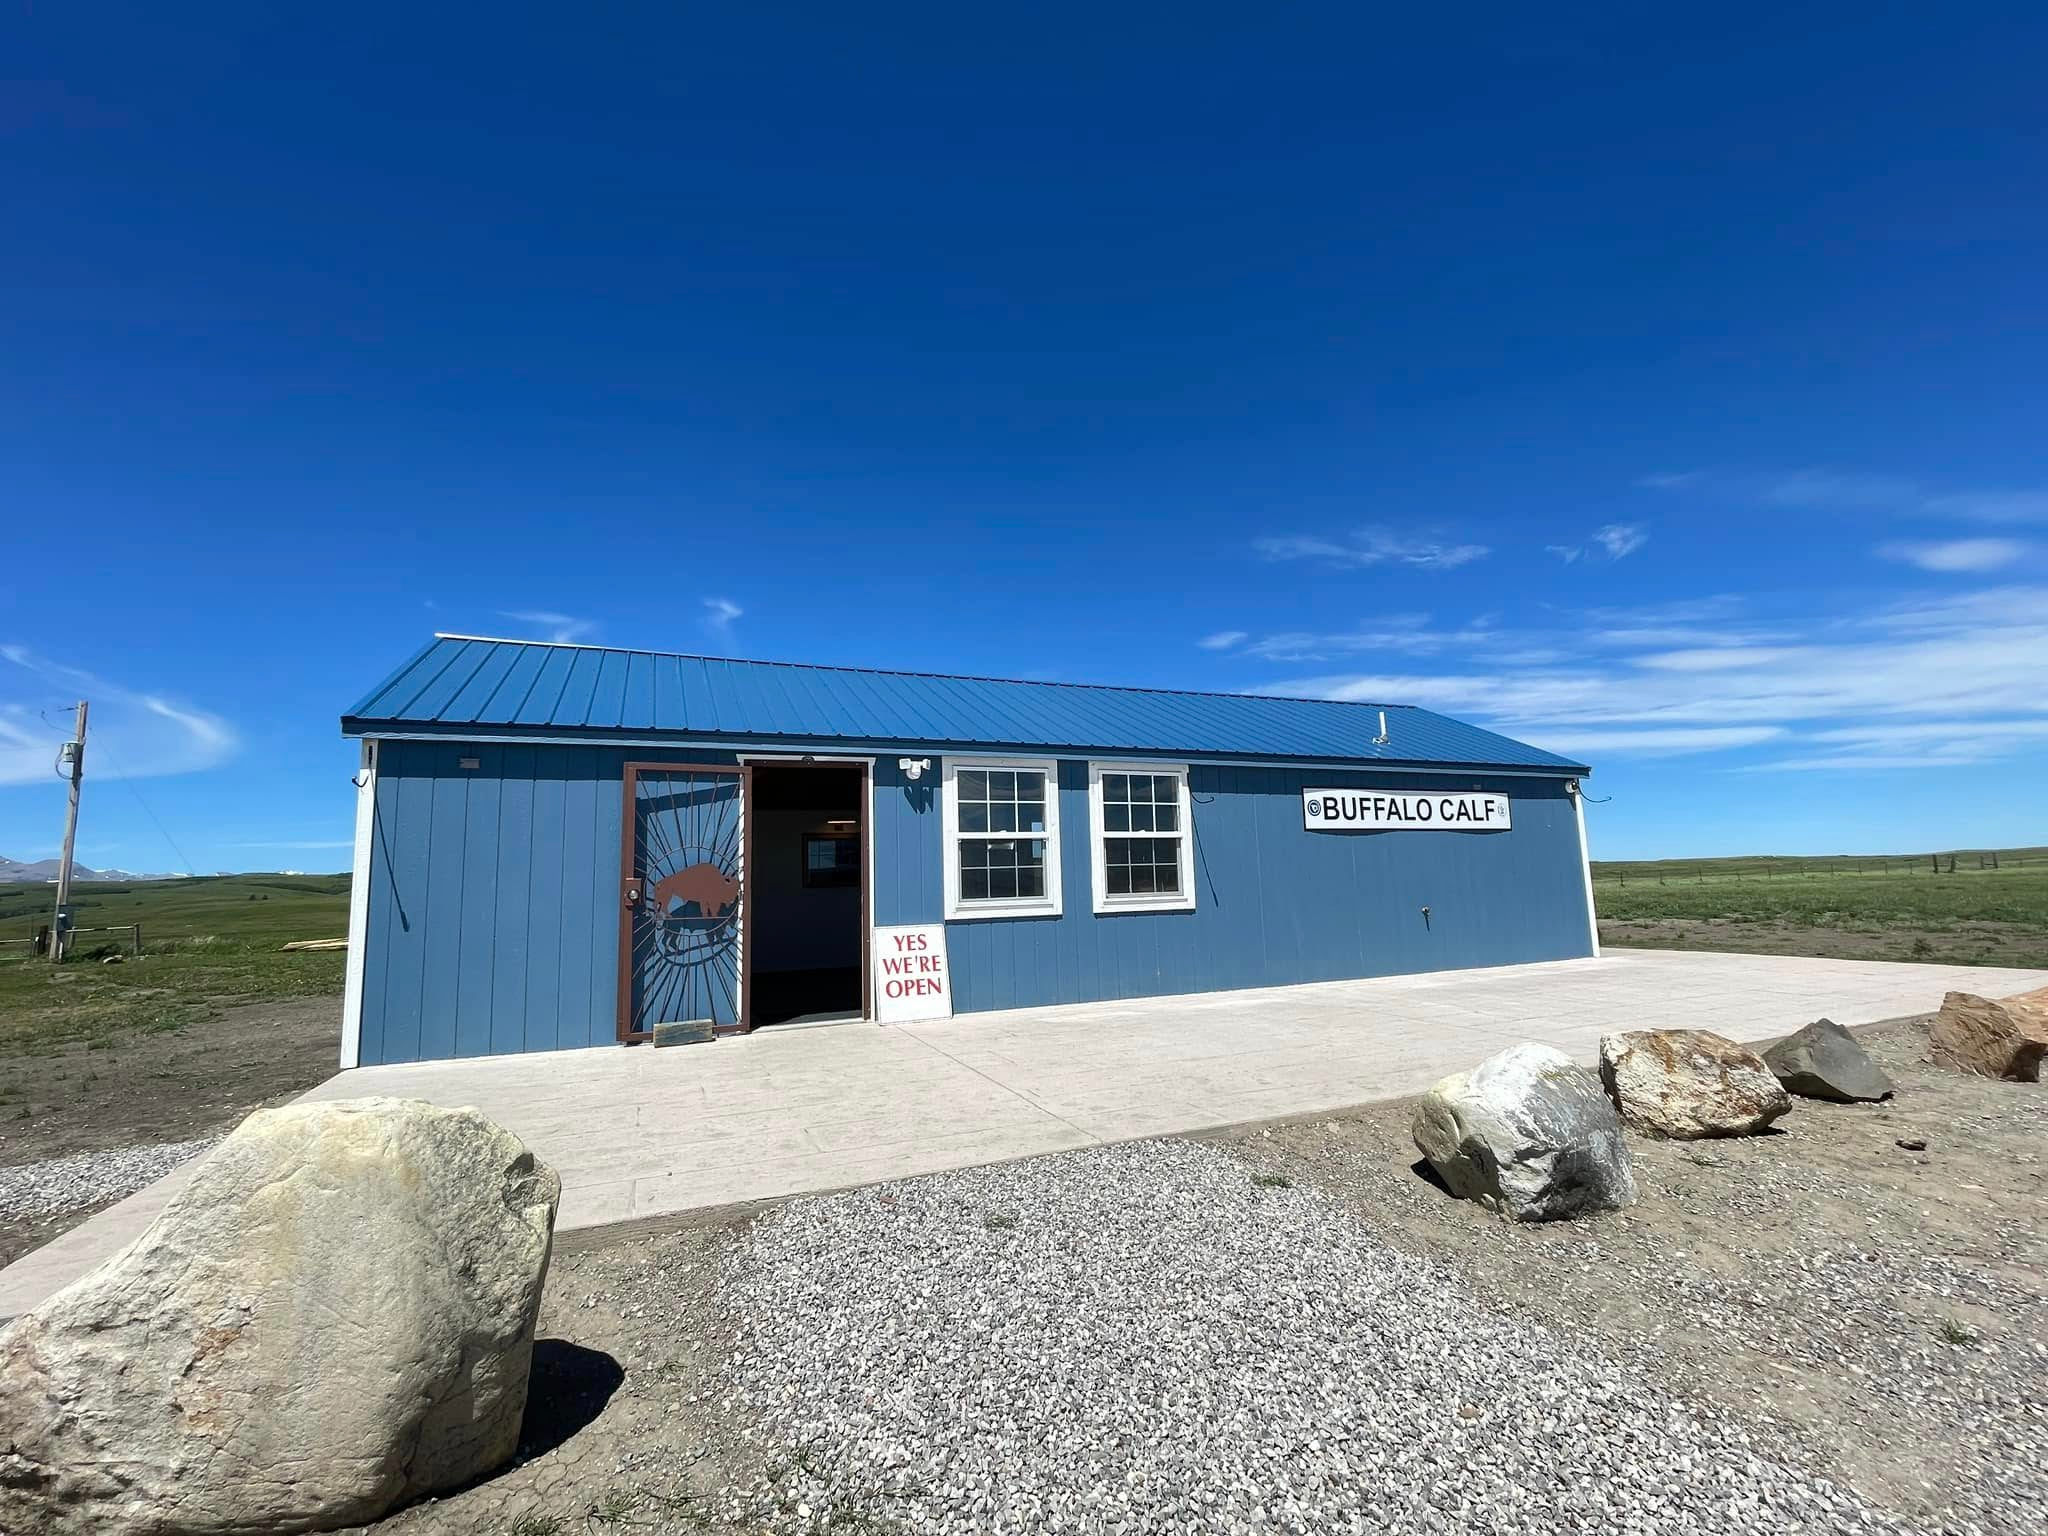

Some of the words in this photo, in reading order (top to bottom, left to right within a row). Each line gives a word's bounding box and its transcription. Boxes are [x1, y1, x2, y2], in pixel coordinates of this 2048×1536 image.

[1323, 796, 1433, 822] BUFFALO
[1439, 799, 1495, 822] CALF
[893, 933, 927, 951] YES
[882, 955, 941, 975] WE'RE
[885, 977, 942, 998] OPEN
